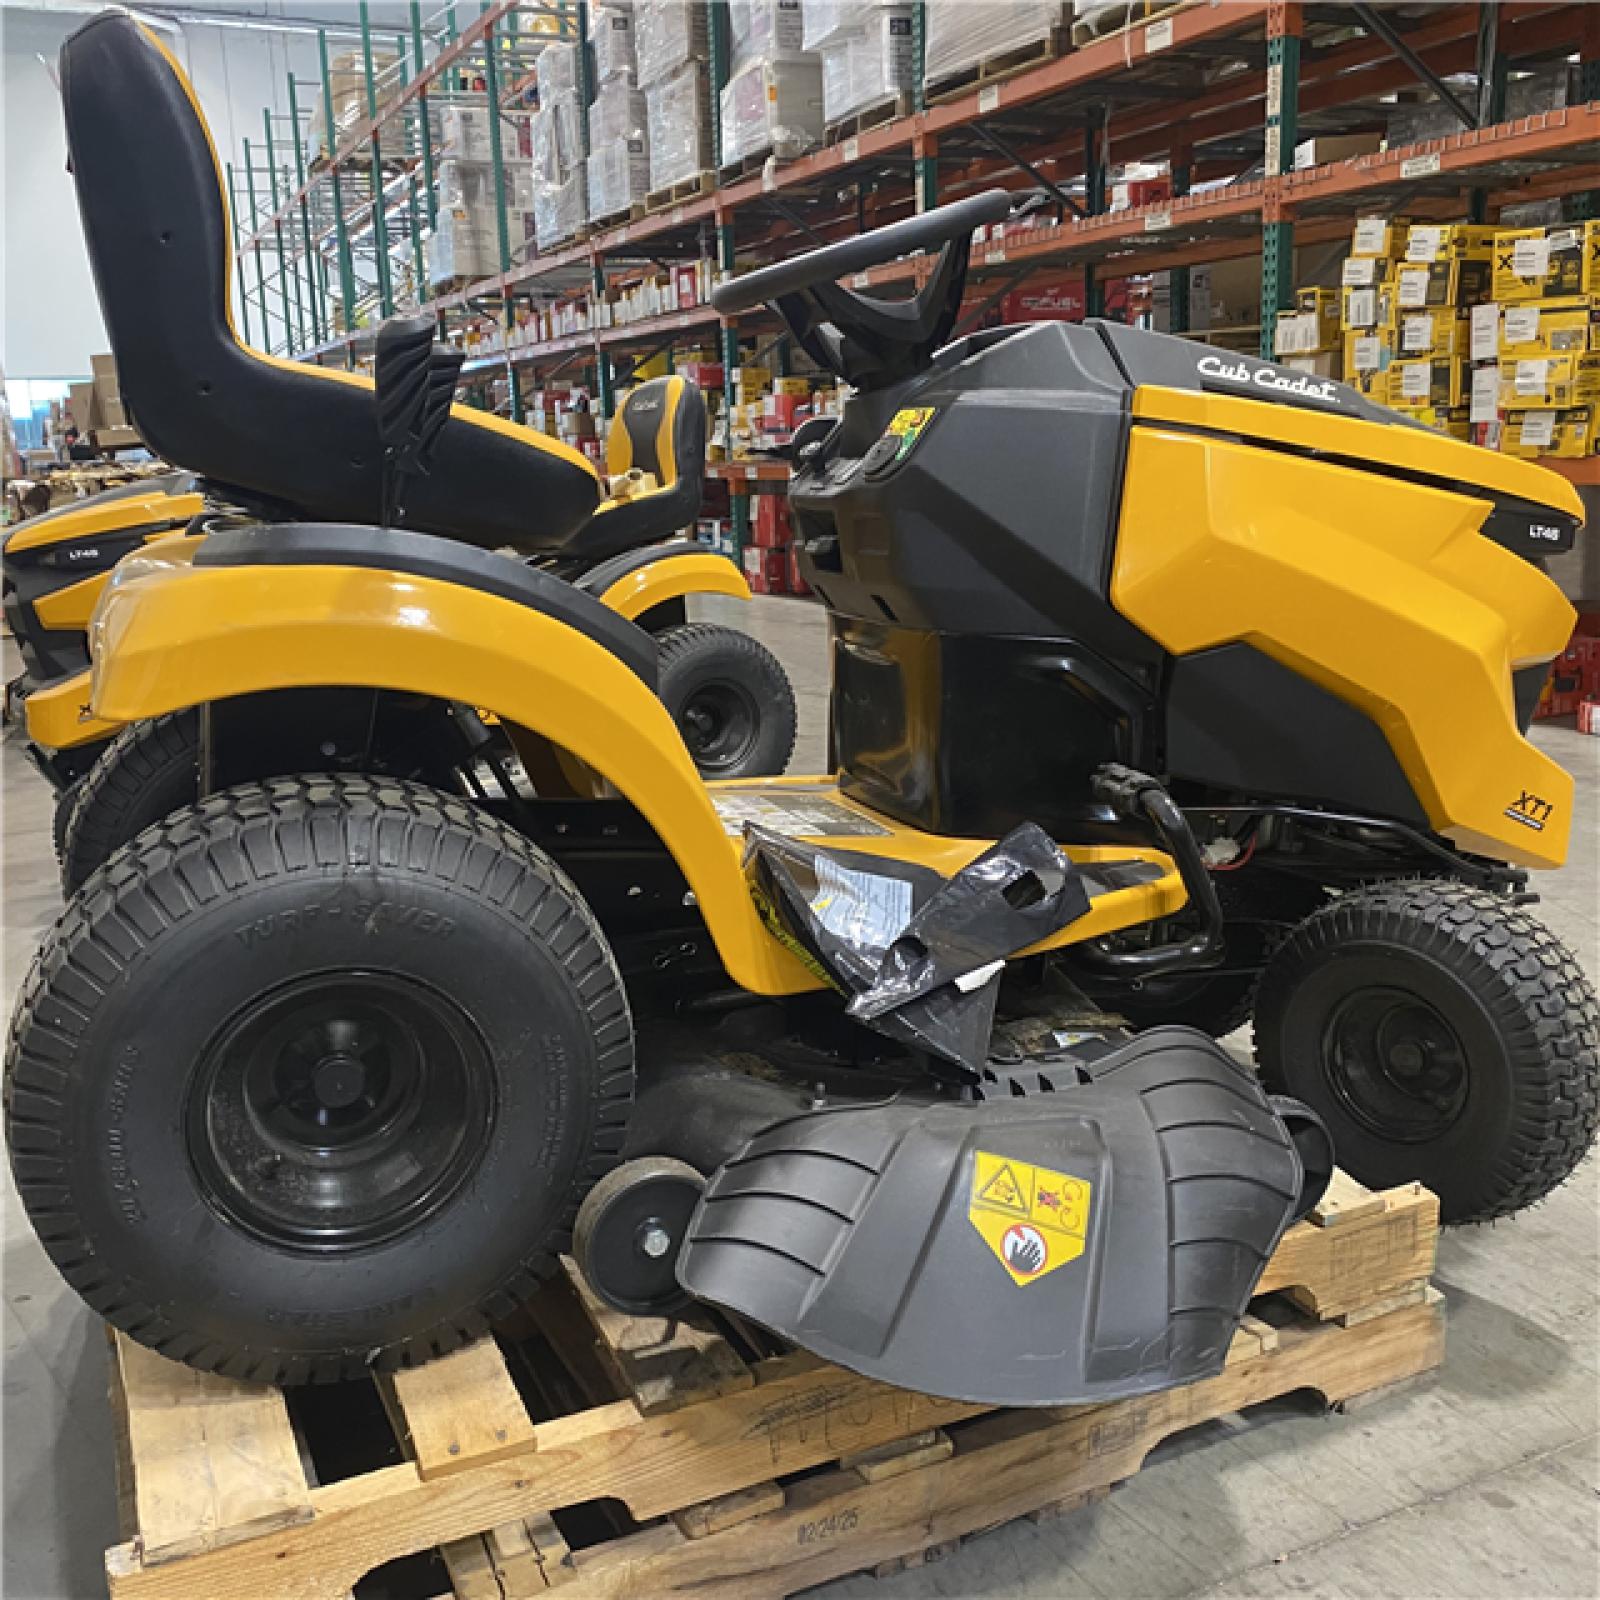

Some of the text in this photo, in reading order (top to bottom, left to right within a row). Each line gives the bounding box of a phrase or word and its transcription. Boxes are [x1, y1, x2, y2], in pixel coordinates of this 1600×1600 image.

[1197, 357, 1337, 402] Cub Cadet
[1511, 789, 1553, 821] XT1
